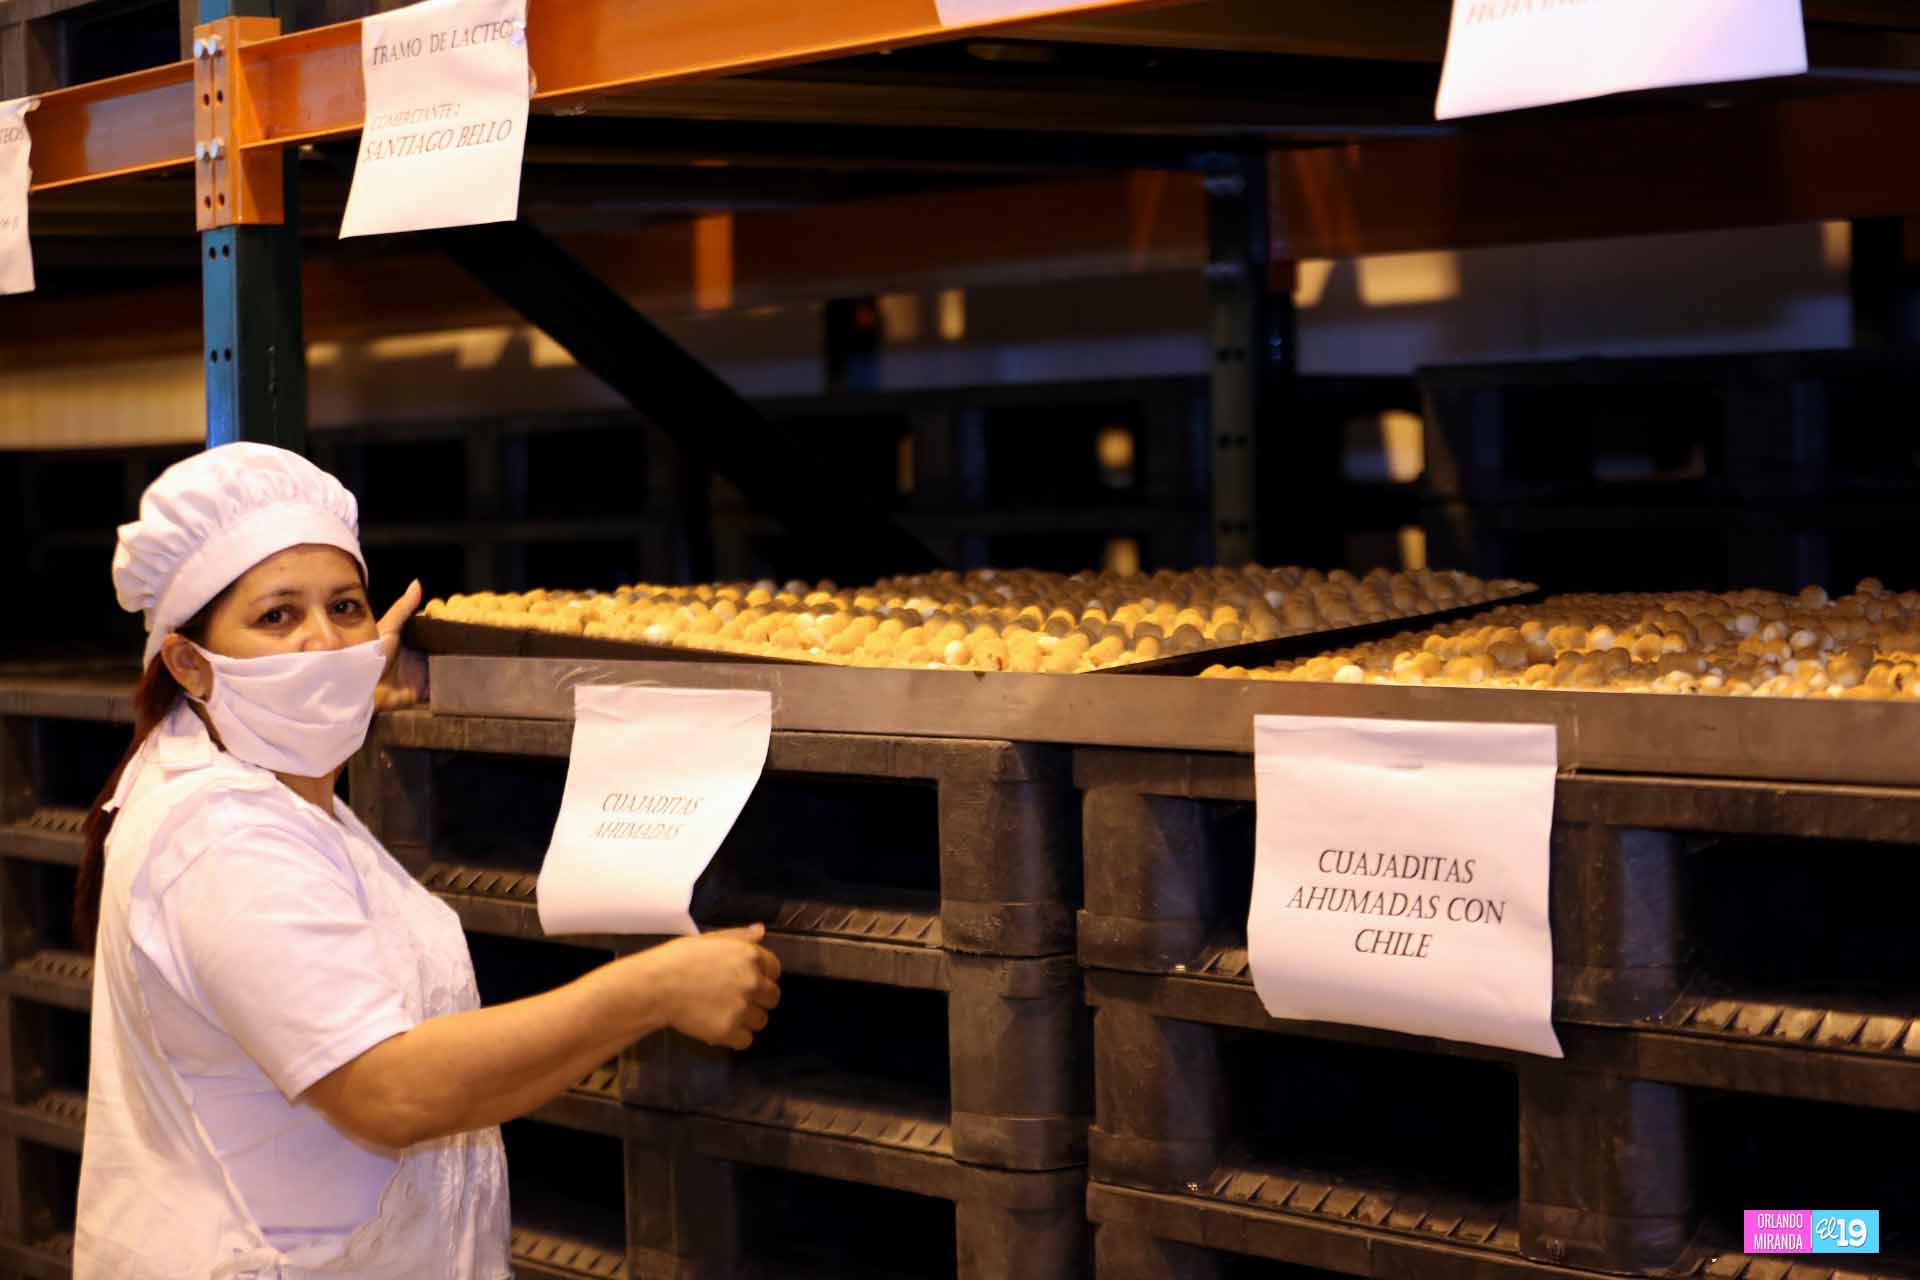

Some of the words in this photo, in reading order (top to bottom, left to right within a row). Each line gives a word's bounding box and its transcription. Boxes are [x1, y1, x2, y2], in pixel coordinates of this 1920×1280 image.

[371, 37, 422, 67] TRAMO
[429, 31, 448, 54] DE
[363, 129, 455, 162] SANTIAGO
[456, 119, 513, 149] BELLO
[601, 793, 705, 816] CUAJADITAS
[590, 821, 687, 841] AHUMADAS
[1318, 849, 1477, 885] CUAJADITAS
[1285, 885, 1441, 920] AHUMADAS
[1447, 897, 1507, 925] CON
[1354, 928, 1434, 959] CHILE
